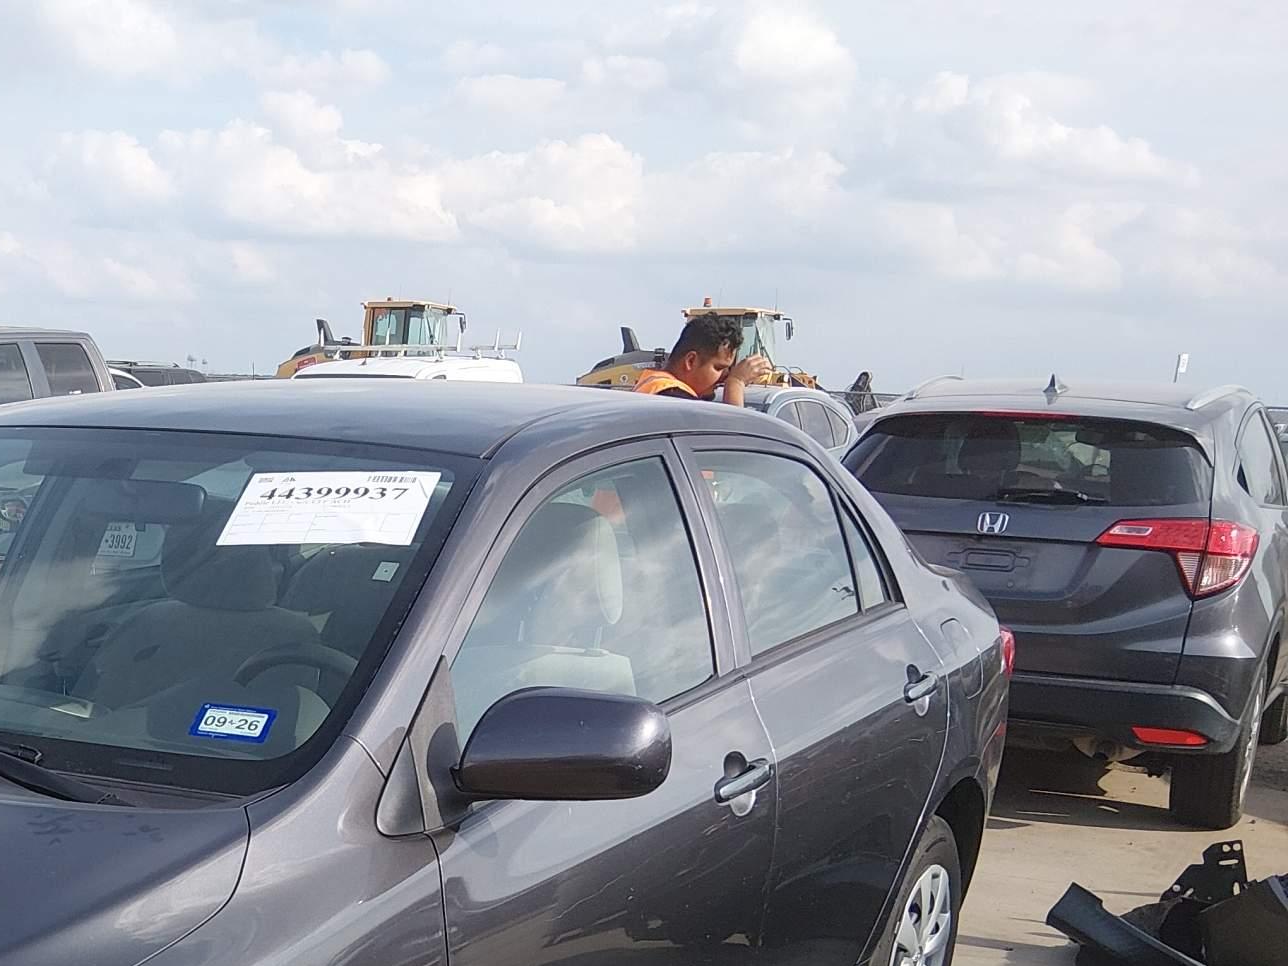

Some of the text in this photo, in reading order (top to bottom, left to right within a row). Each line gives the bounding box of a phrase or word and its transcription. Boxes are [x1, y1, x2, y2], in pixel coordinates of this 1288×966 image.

[260, 487, 409, 500] 44399937
[204, 715, 260, 731] 09 26
